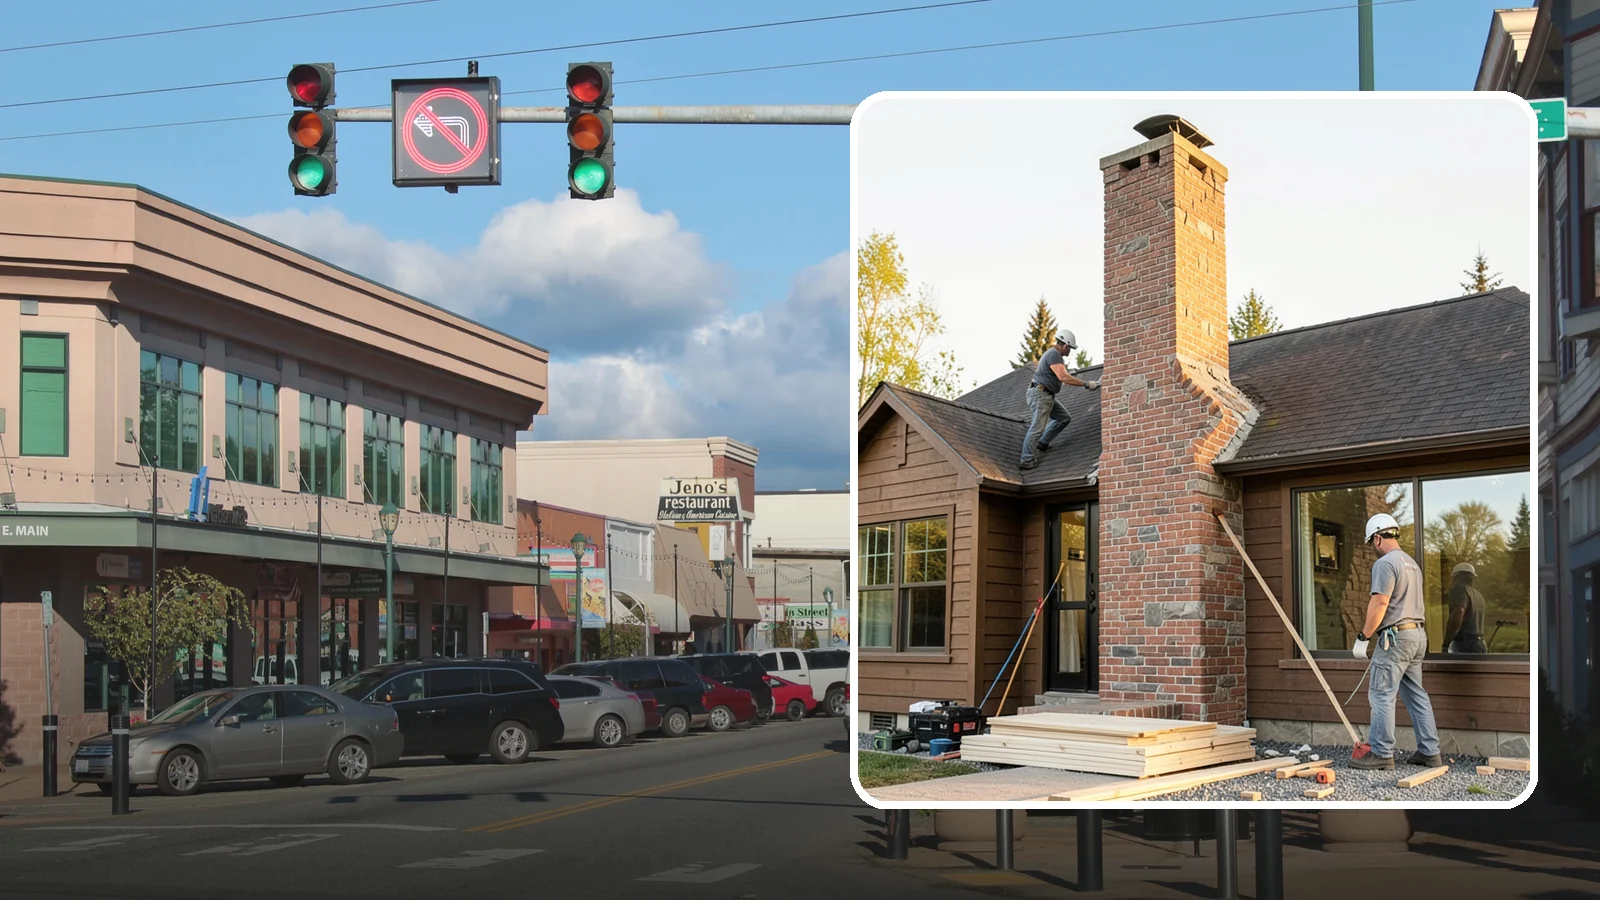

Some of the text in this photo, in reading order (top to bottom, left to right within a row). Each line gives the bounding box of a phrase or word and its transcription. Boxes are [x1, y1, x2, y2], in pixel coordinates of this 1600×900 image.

[669, 480, 728, 494] Jeno's
[665, 496, 731, 509] restaurant
[658, 510, 681, 519] Italian
[686, 510, 714, 520] American
[715, 510, 737, 519] Cuisine
[2, 525, 49, 536] E. MAIN
[797, 607, 828, 617] Street
[791, 619, 824, 627] lass
